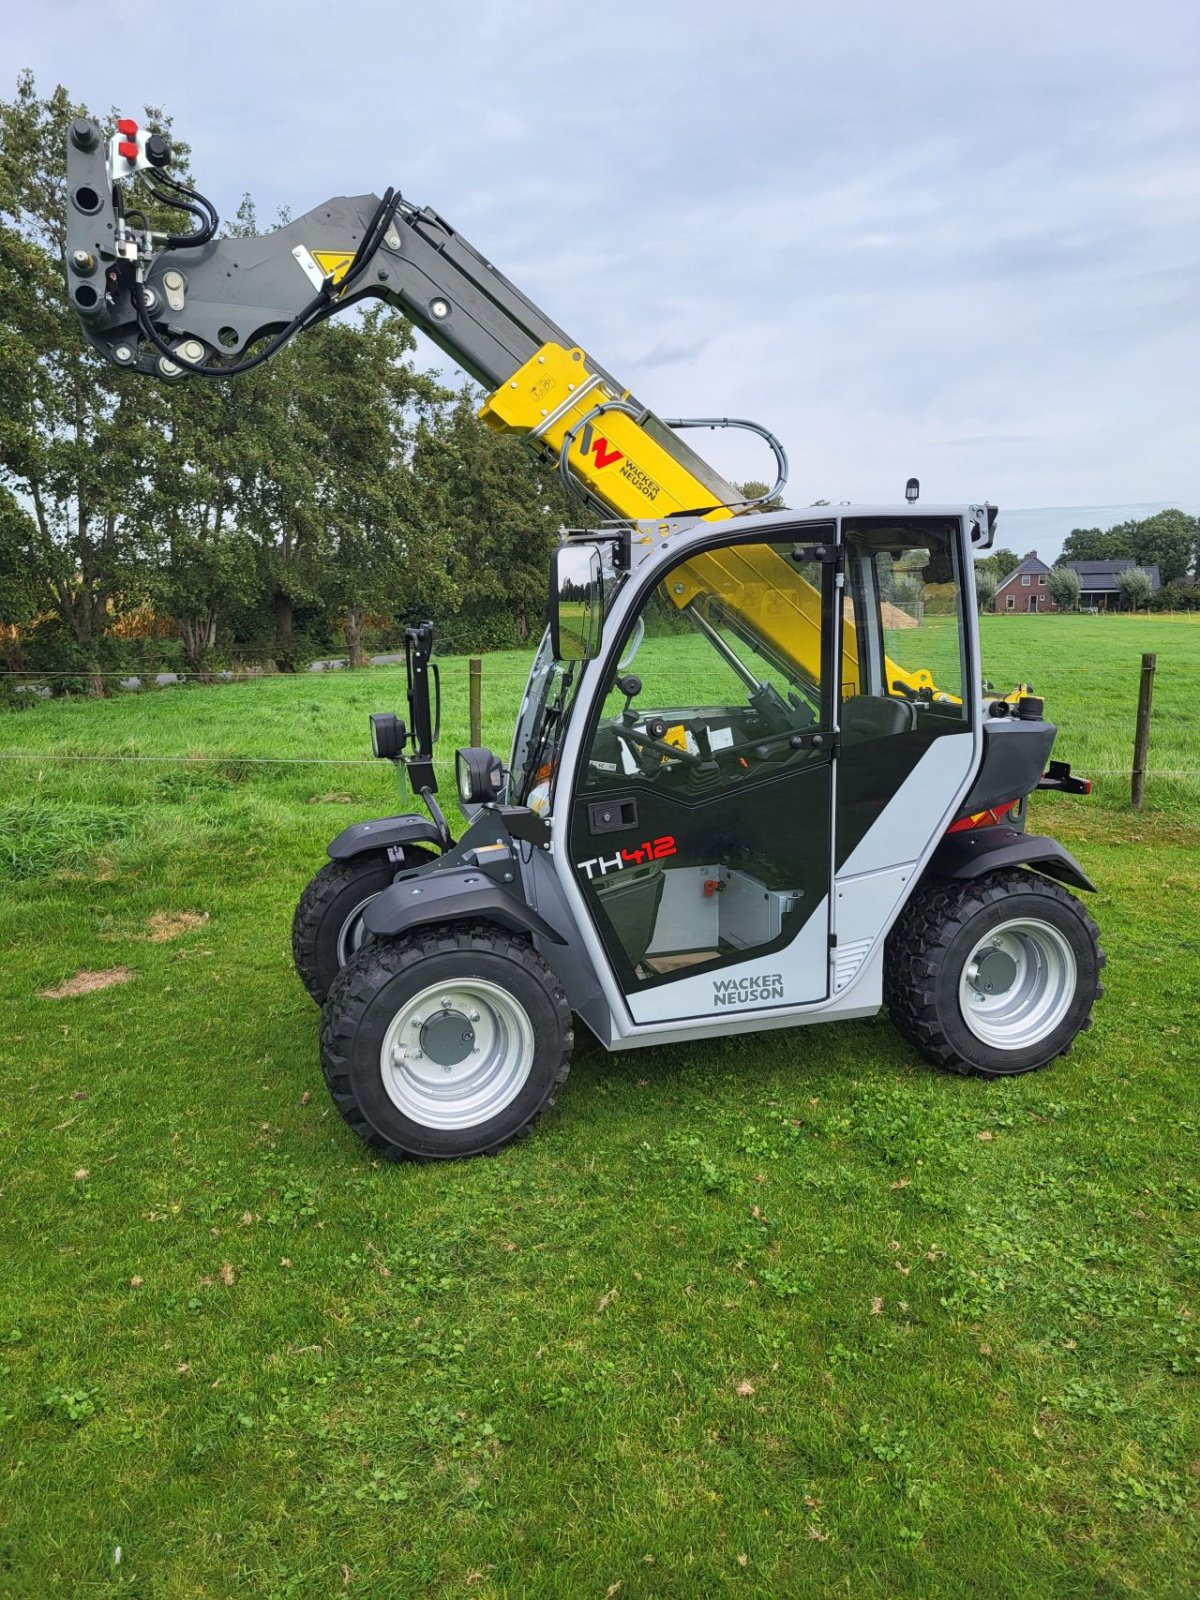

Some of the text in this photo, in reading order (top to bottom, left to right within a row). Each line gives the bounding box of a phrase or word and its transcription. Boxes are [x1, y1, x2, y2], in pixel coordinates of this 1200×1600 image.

[620, 466, 656, 501] NEUSON
[625, 459, 660, 495] WACKER
[577, 836, 677, 879] TH412
[712, 974, 783, 993] WACKER
[714, 986, 784, 1006] NEUSON
